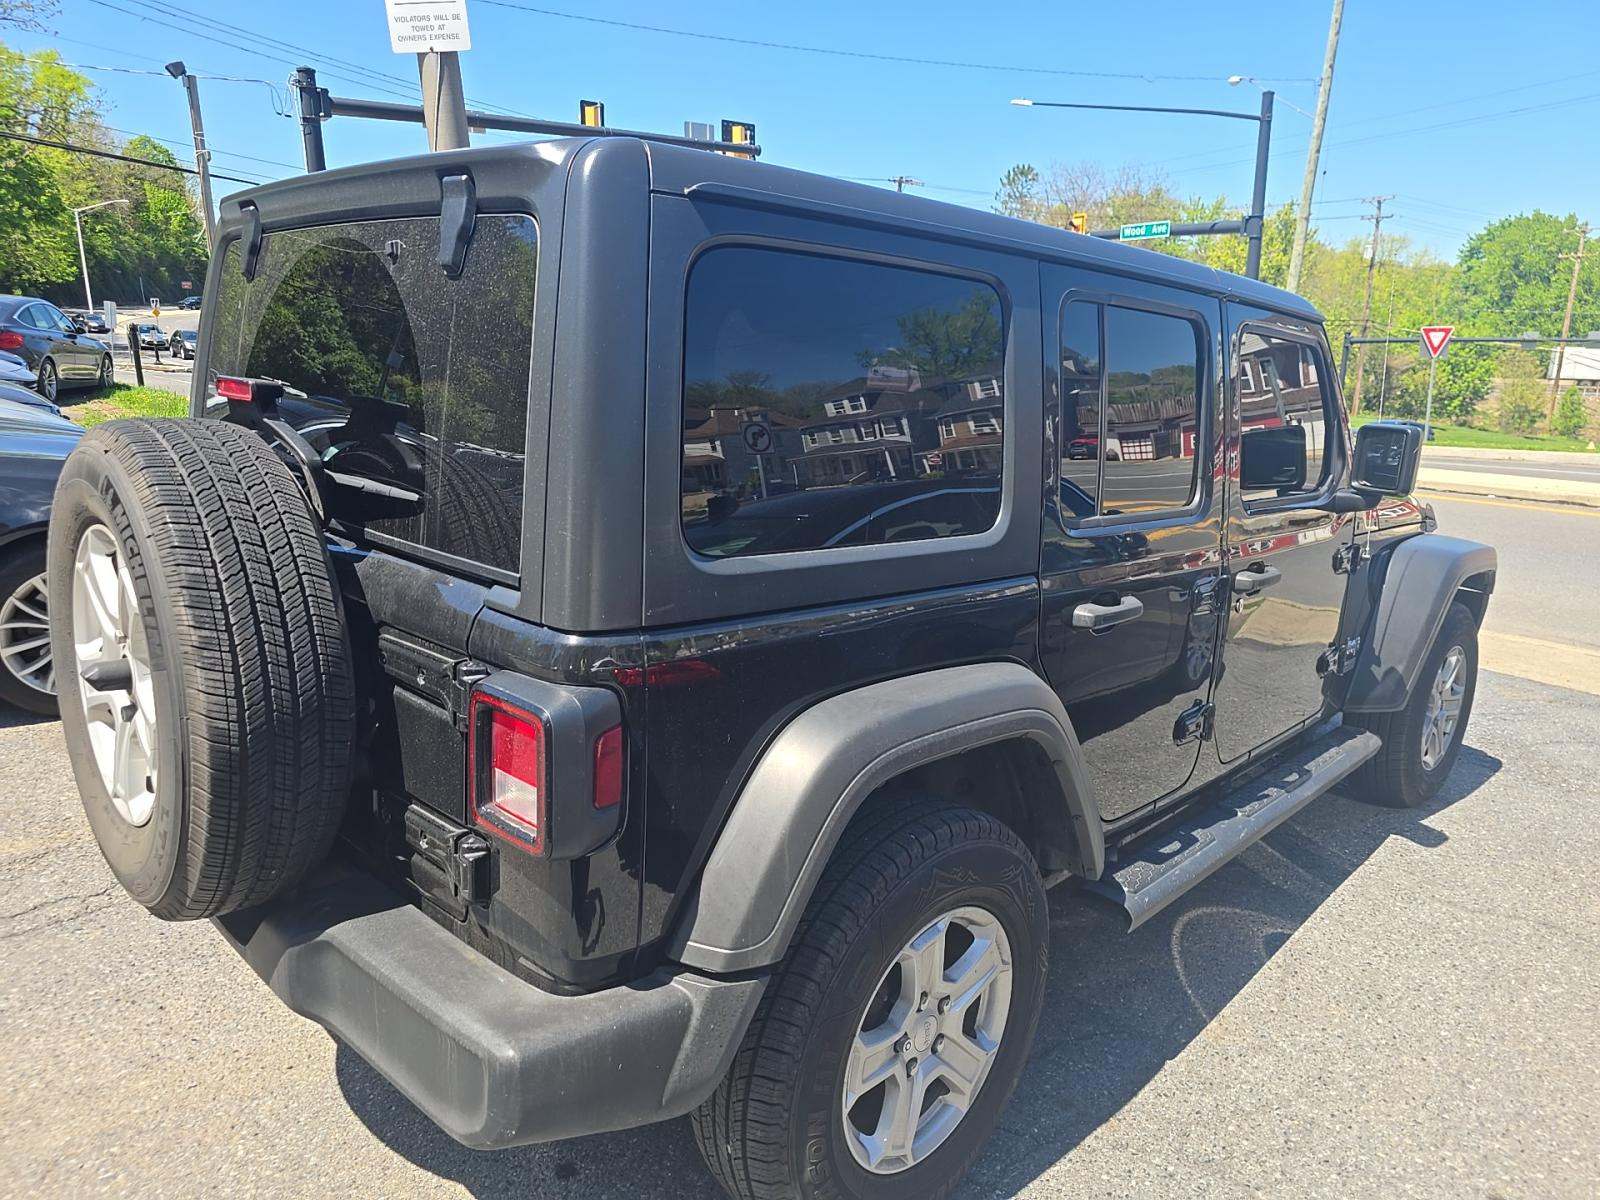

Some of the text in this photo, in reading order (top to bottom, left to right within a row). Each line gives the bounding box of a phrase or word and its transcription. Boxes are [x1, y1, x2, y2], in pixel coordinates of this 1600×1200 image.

[394, 14, 431, 23] VIOLATORS
[451, 13, 462, 21] BE
[397, 33, 461, 42] OWNERS EXPENSE
[1124, 226, 1145, 236] Wood
